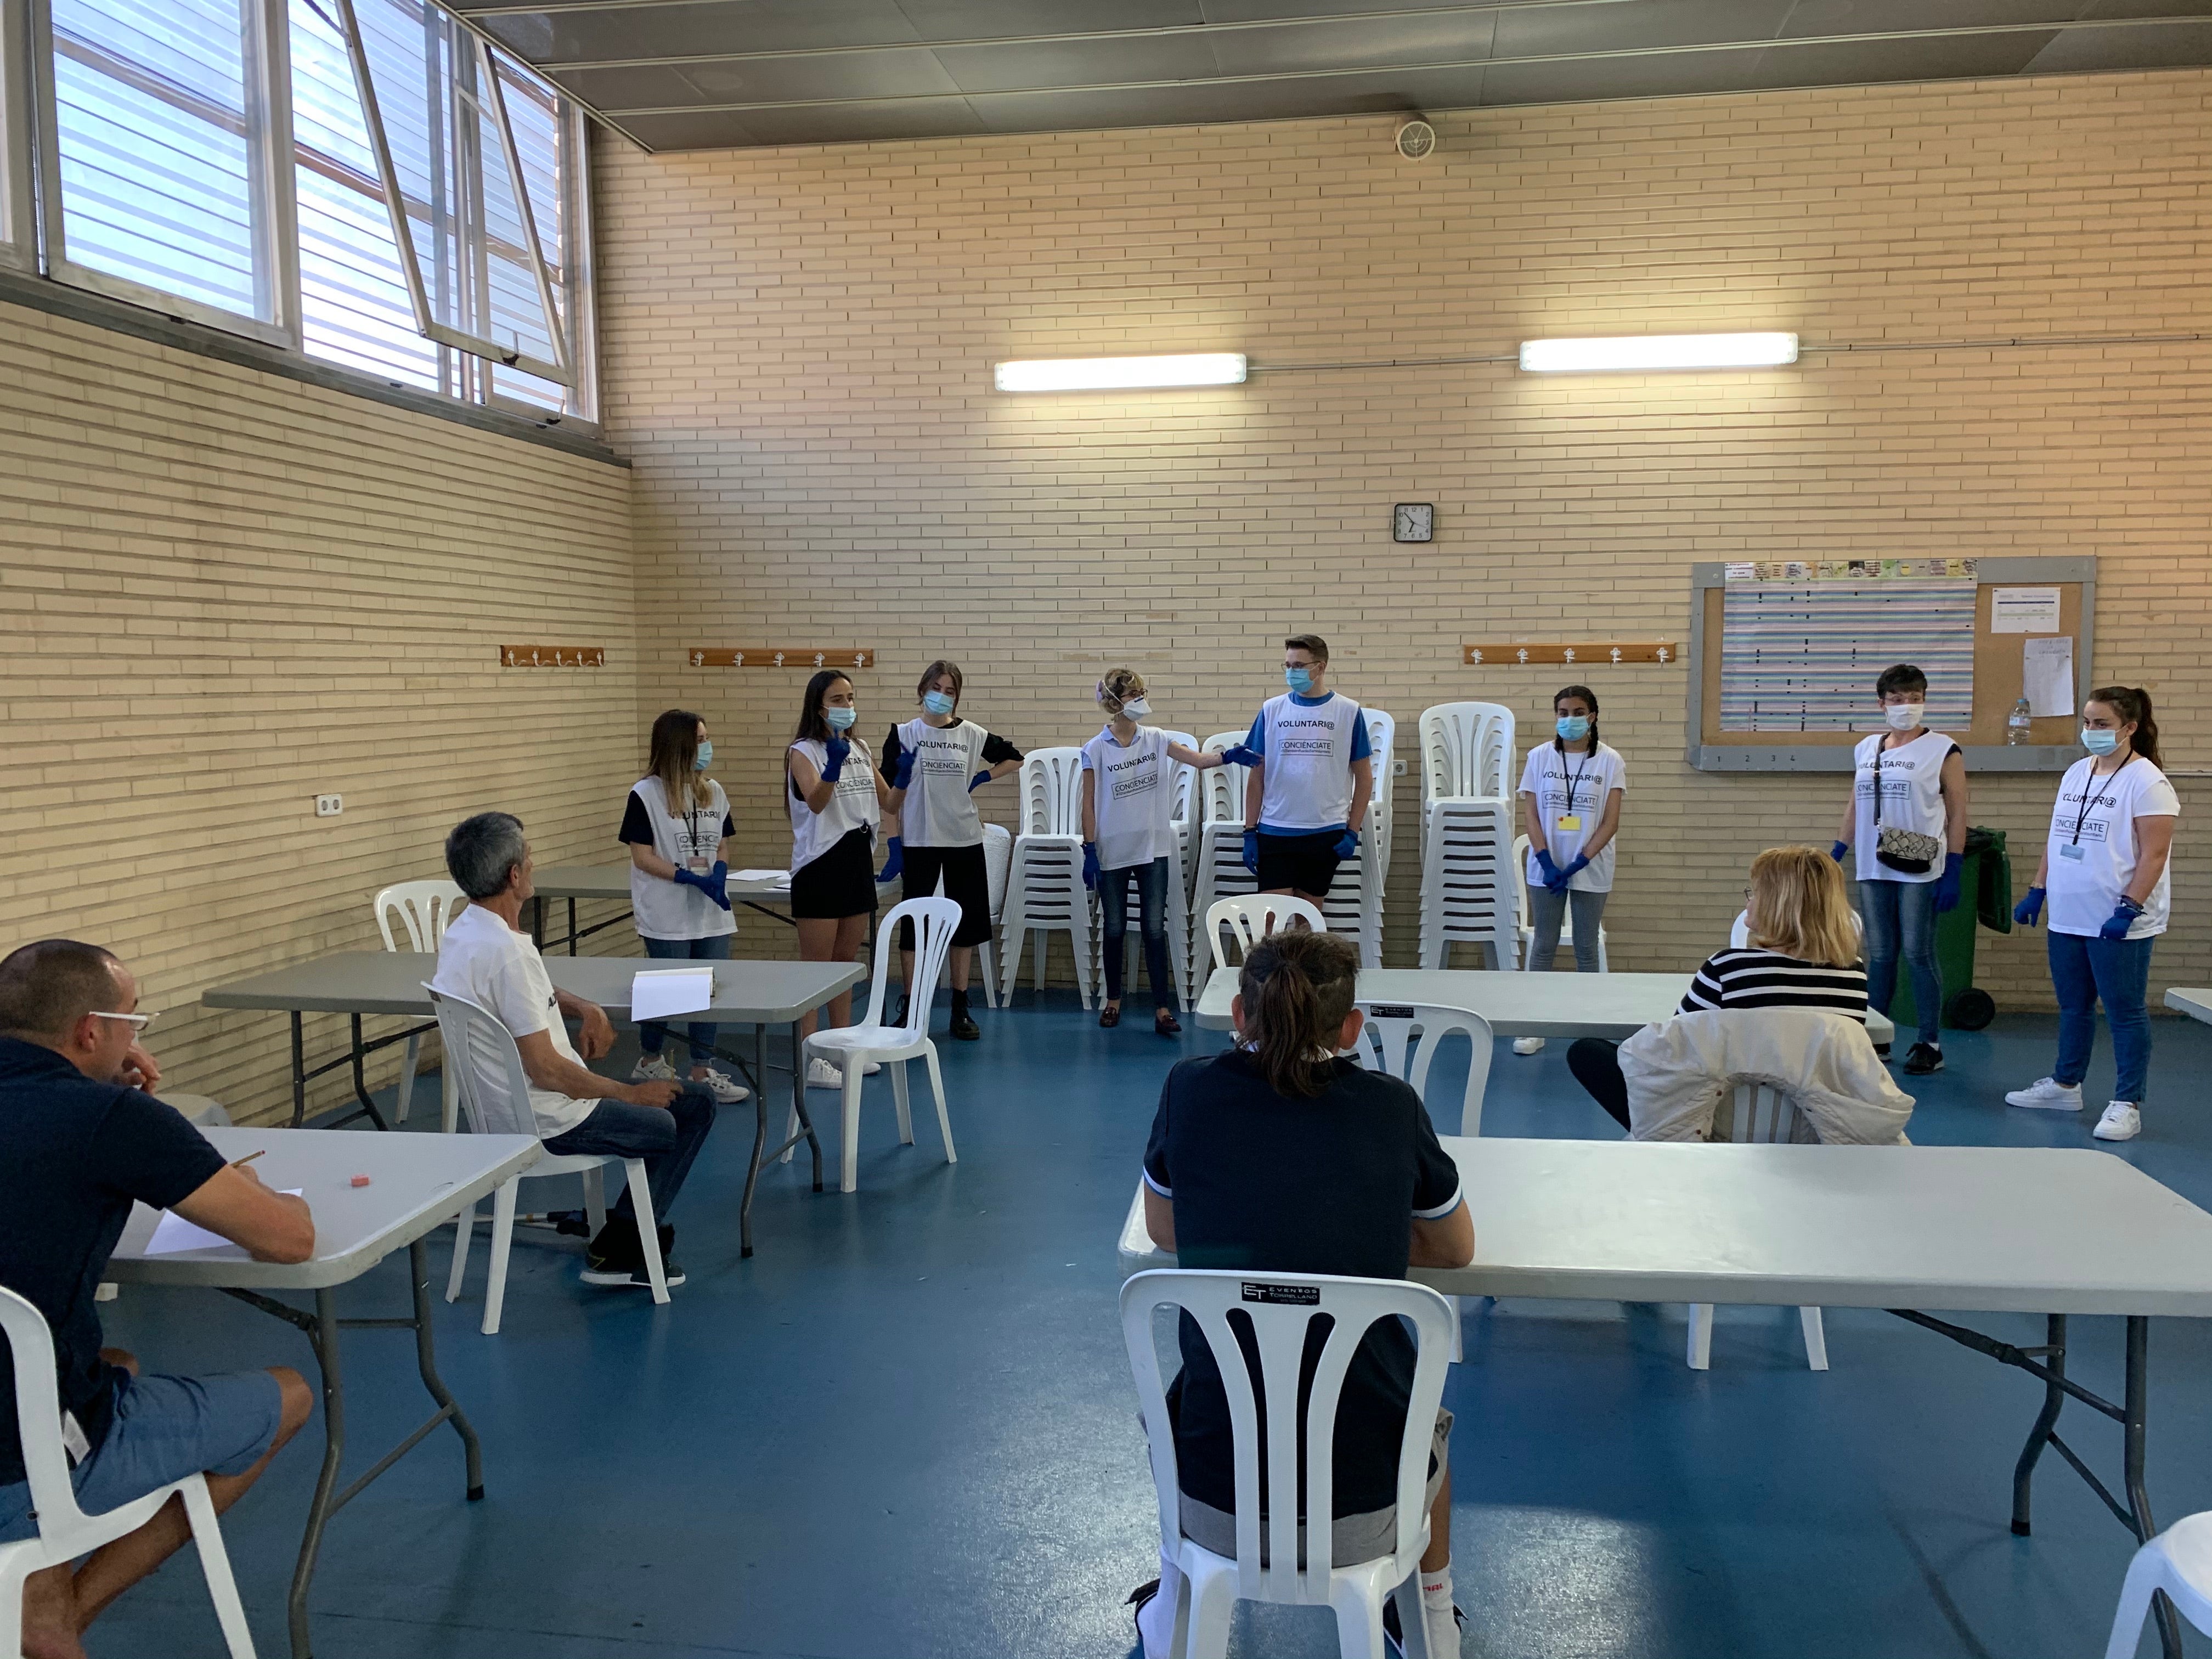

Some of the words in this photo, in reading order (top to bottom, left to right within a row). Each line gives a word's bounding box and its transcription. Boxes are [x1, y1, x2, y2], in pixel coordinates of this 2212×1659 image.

[1278, 720, 1335, 730] VOLUNTARI@
[1107, 752, 1157, 772] VOLUNTARI@
[1372, 1007, 1384, 1015] ET
[1243, 1284, 1267, 1300] ET
